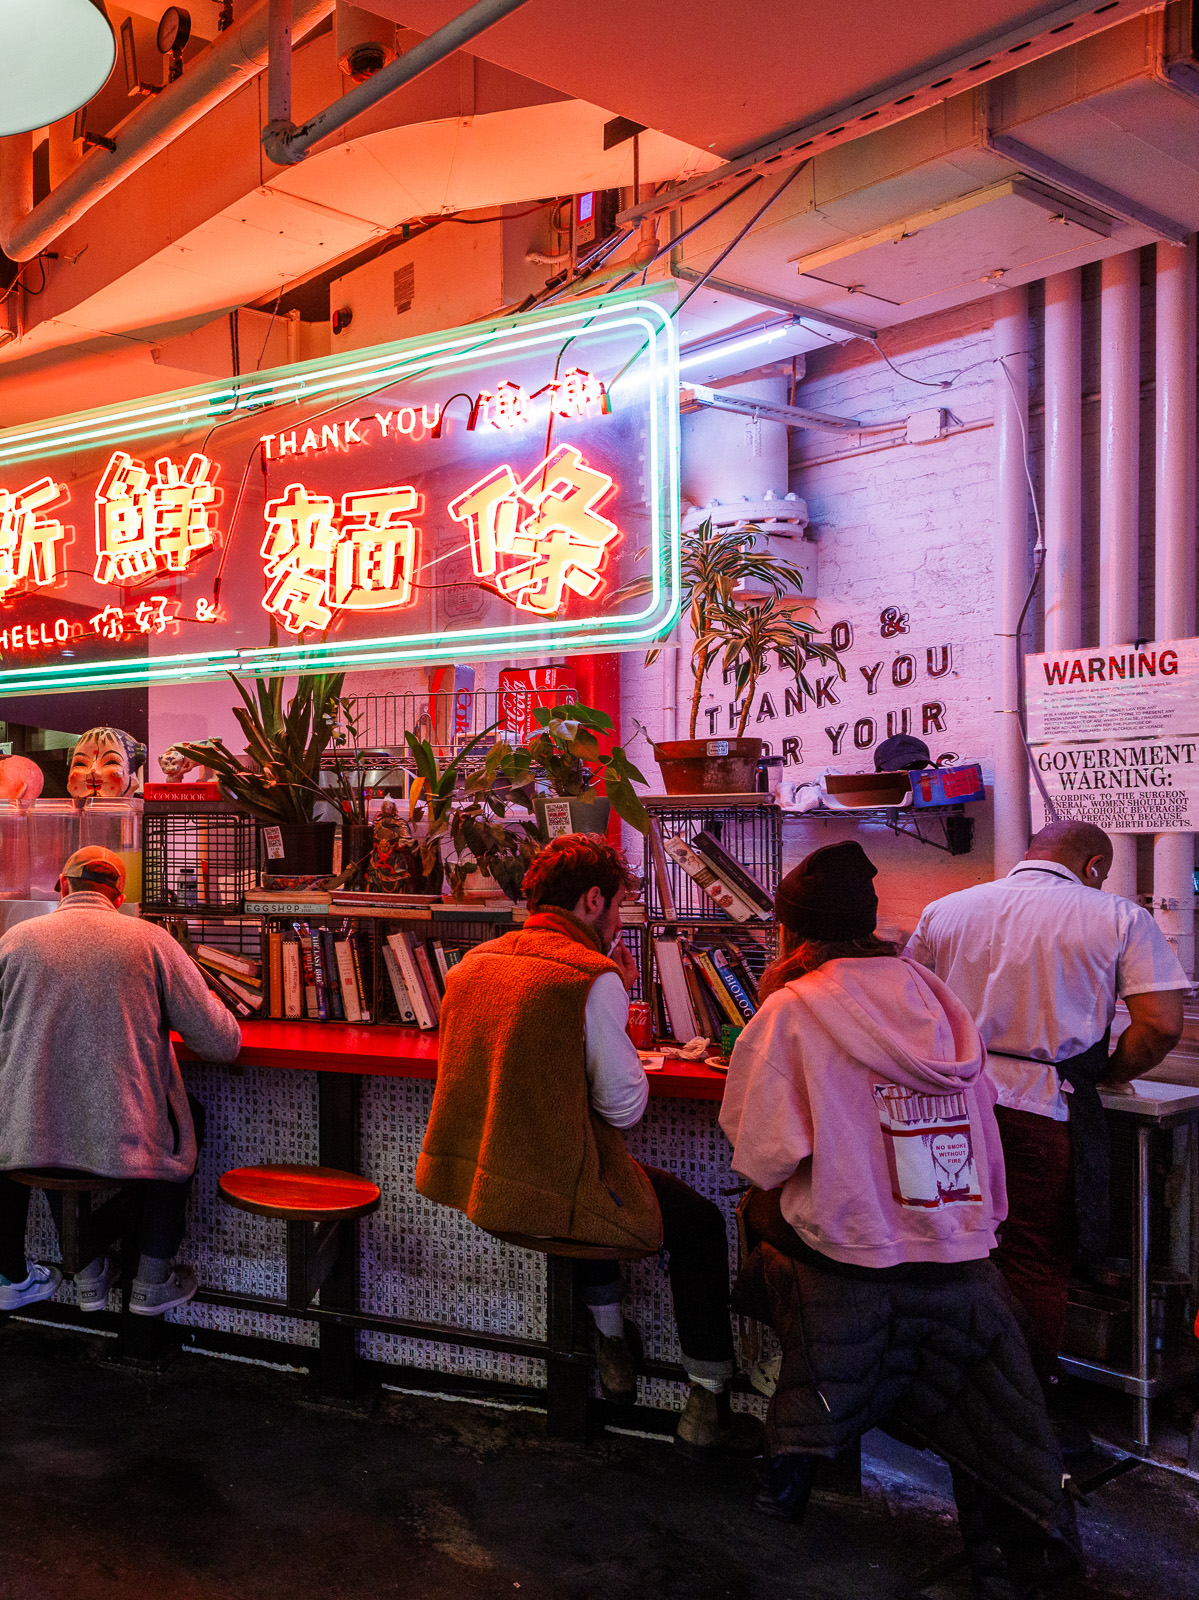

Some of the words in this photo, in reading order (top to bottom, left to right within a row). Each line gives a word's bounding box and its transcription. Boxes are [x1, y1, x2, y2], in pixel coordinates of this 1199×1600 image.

[260, 418, 360, 460] THANK
[375, 402, 440, 438] YOU
[89, 596, 174, 639] 你好
[195, 598, 217, 621] &
[880, 605, 912, 639] &
[1043, 650, 1179, 686] WARNING
[704, 674, 842, 737] THANK
[859, 642, 953, 696] YOU
[824, 700, 948, 756] YOUR
[1038, 744, 1197, 772] GOVERNMENT
[1058, 767, 1173, 791] WARNING:
[1049, 793, 1096, 802] CCORDING
[1099, 792, 1112, 801] TO
[1115, 791, 1135, 800] THE
[1139, 790, 1186, 799] SURGEON
[1090, 799, 1126, 808] WOMEN
[1127, 798, 1167, 807] SHOULD
[1168, 797, 1190, 806] NOT
[1076, 806, 1129, 815] ALCOHOLIC
[1130, 804, 1188, 814] BEVERAGES
[1081, 813, 1136, 822] PREGNANCY
[1137, 812, 1183, 821] BECAUSE
[1115, 820, 1144, 829] BIRTH
[1146, 819, 1193, 828] DEFECTS.
[312, 936, 320, 950] THE
[938, 1150, 967, 1158] WITHOUT
[946, 1142, 967, 1150] SMOKE
